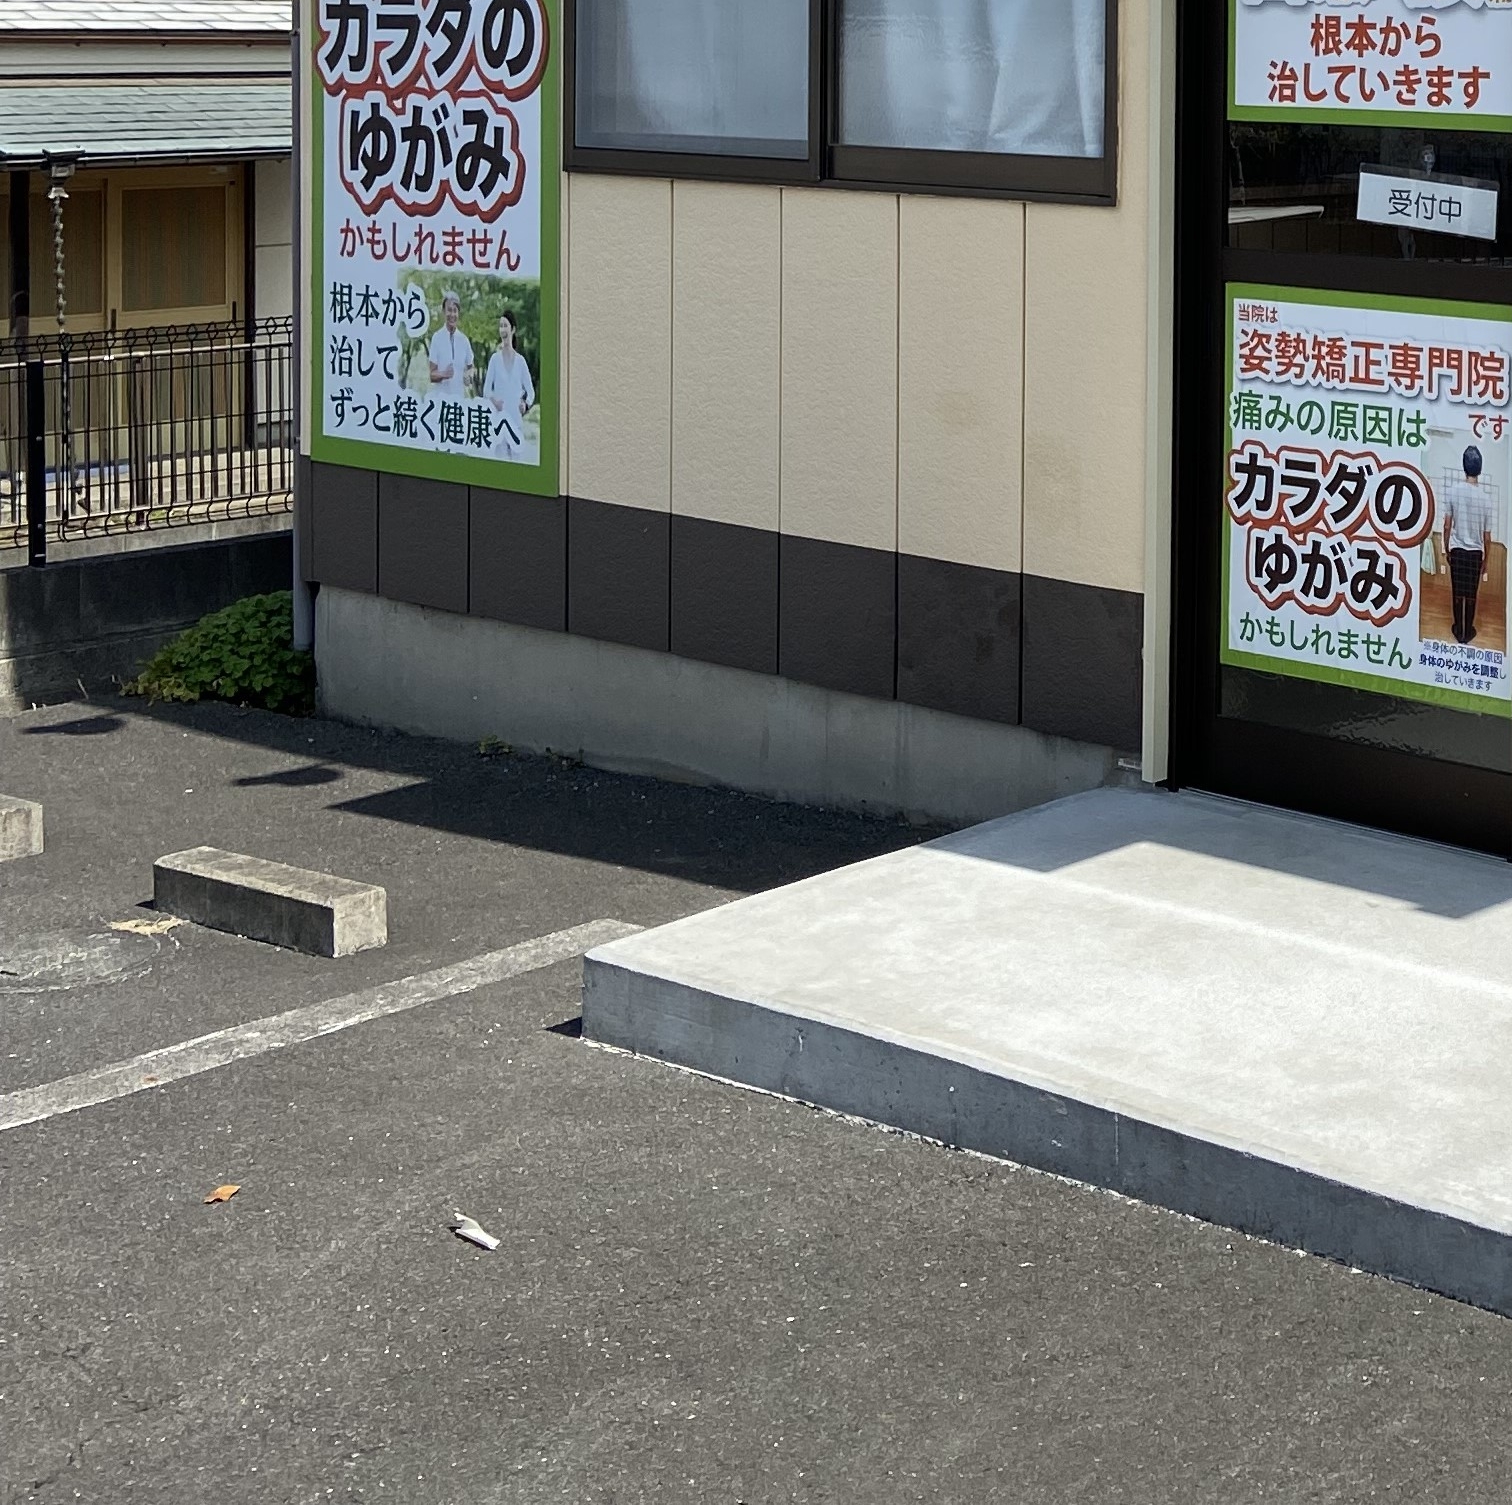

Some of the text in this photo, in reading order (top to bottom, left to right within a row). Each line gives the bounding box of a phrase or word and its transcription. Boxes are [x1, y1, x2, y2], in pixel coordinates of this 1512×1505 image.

[1310, 12, 1442, 59] 根本から
[1266, 59, 1491, 109] 治していきます
[350, 102, 511, 200] ゆがみ
[1388, 188, 1462, 224] 受付中
[340, 218, 521, 272] かもしれません
[329, 281, 426, 331] 根本から
[1237, 303, 1279, 323] 当院は
[329, 334, 399, 381] 治して
[1239, 328, 1505, 400] 姿勢矯正専門院
[330, 388, 521, 448] ずっと続く健康へ
[1232, 390, 1428, 447] 痛みの原因は
[1468, 414, 1509, 441] です
[1233, 452, 1423, 532] カラダの
[1255, 533, 1400, 611] ゆがみ
[1239, 611, 1413, 670] かもしれません
